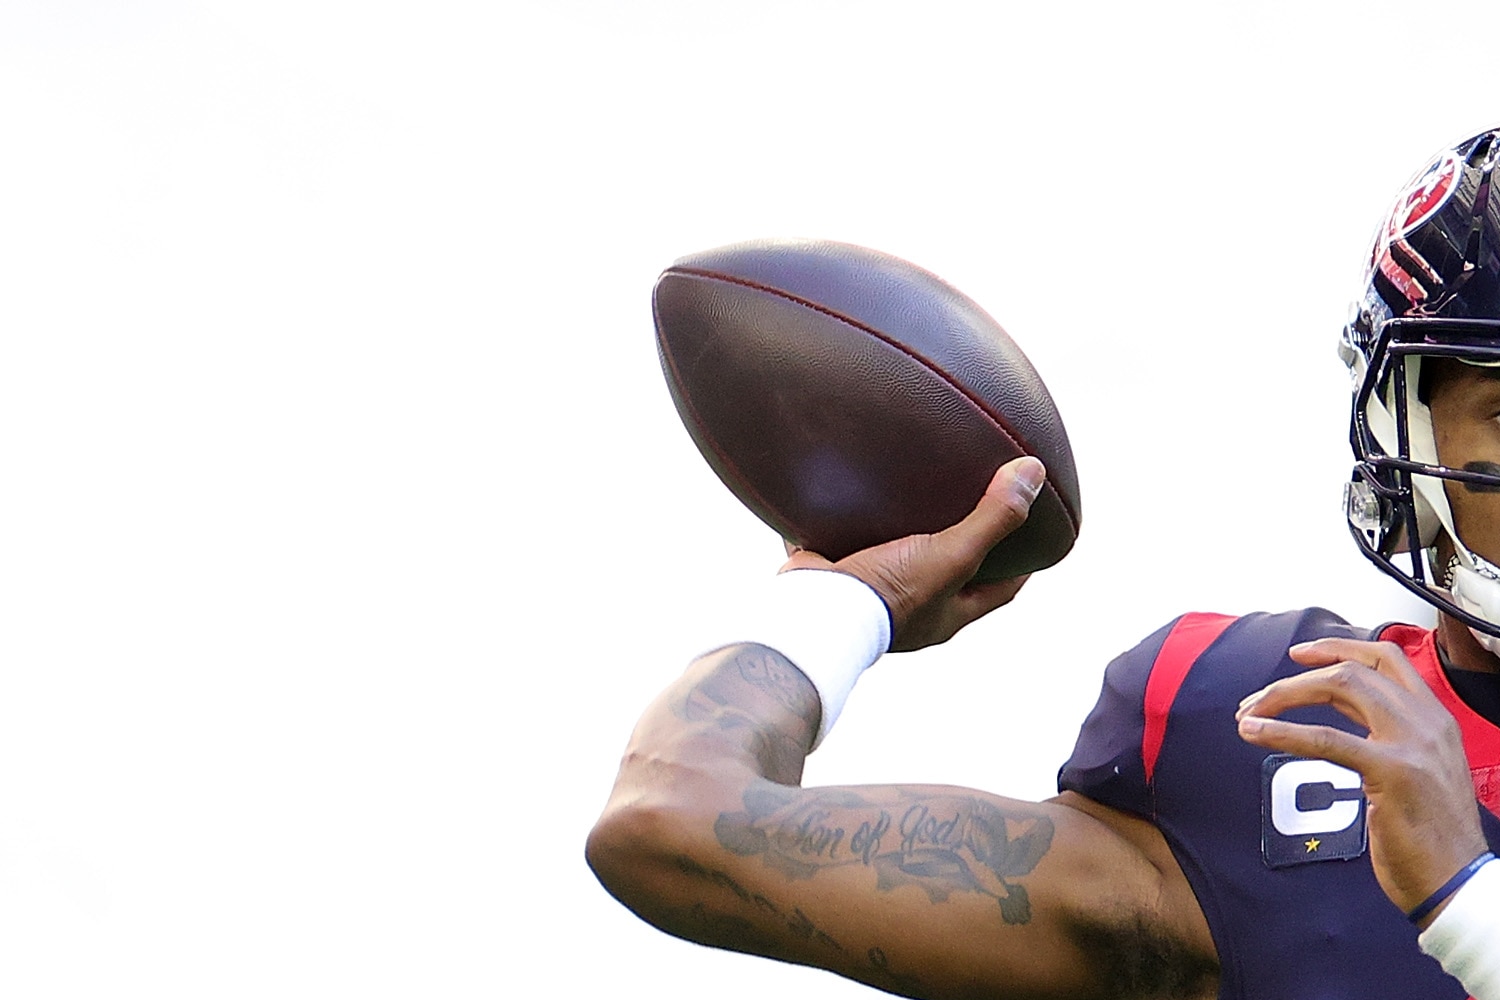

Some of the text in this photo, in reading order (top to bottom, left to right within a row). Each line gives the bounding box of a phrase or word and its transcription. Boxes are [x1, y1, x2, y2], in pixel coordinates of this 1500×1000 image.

[1271, 759, 1362, 836] C
[850, 810, 892, 866] of
[900, 803, 962, 857] God
